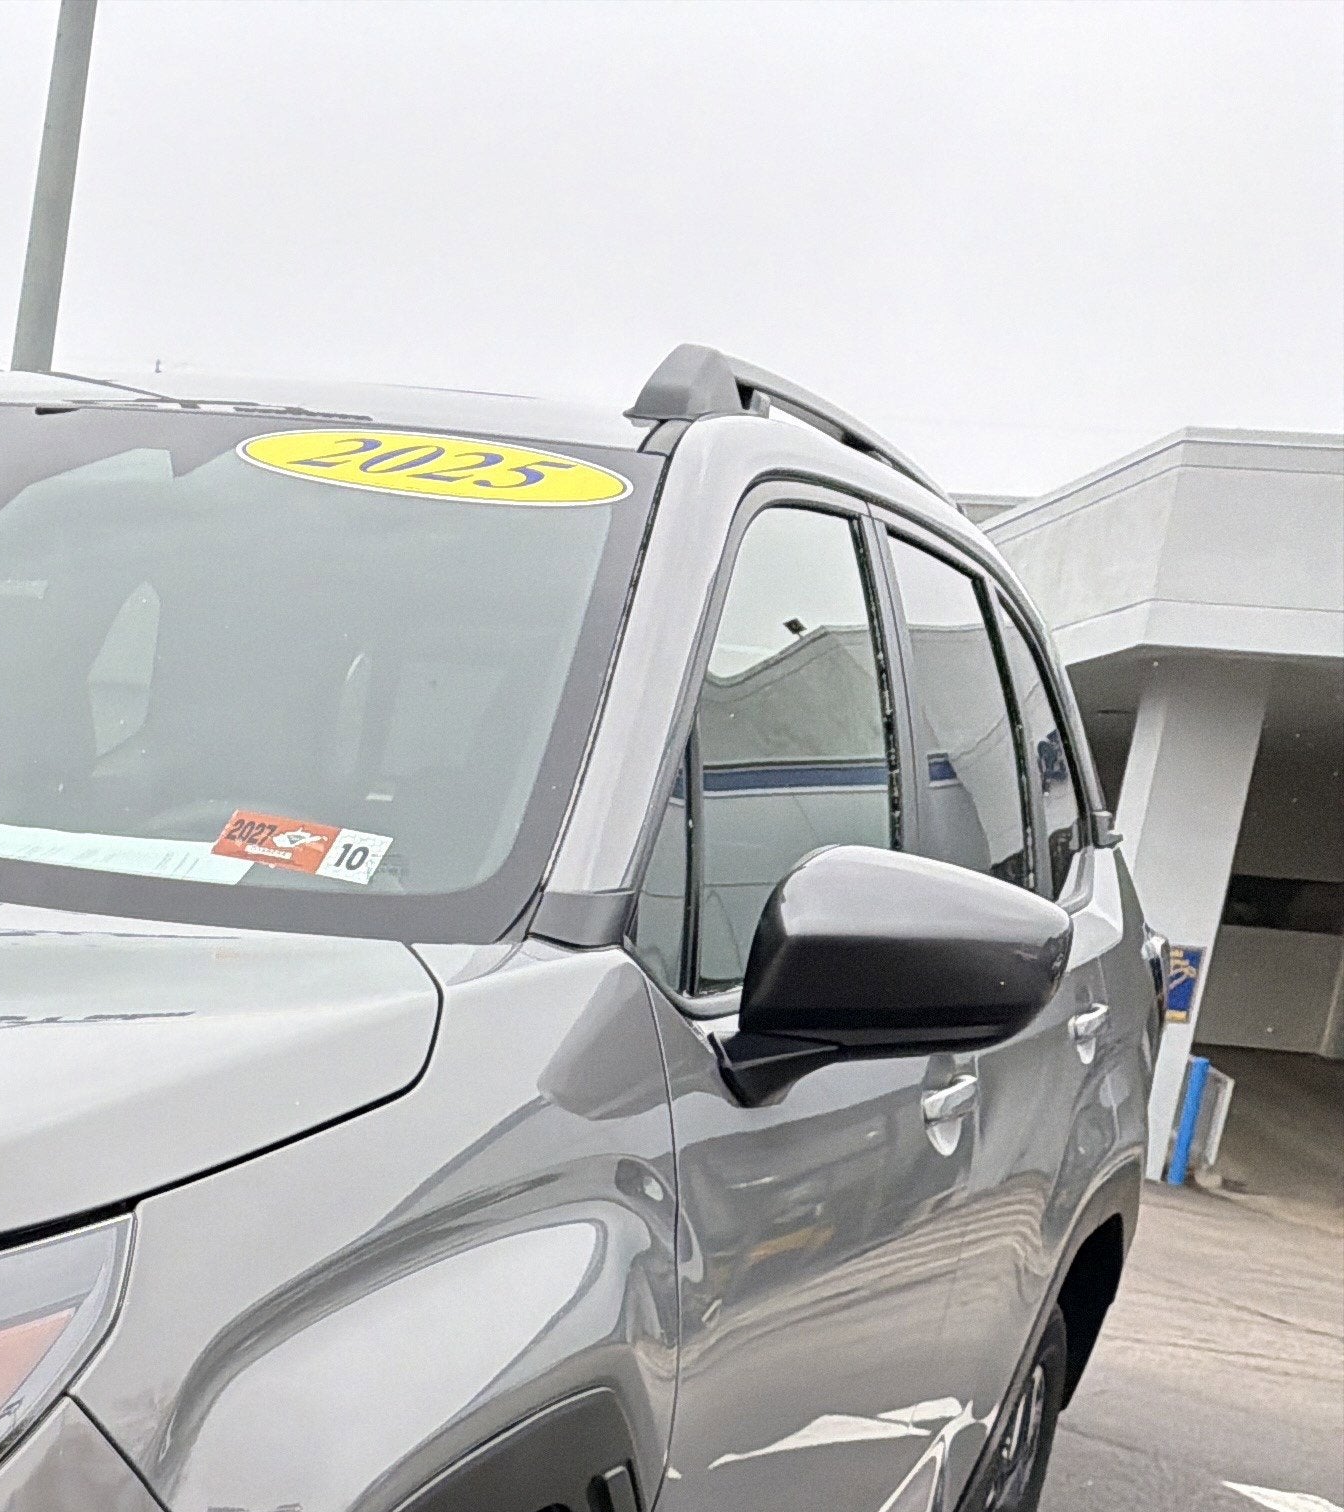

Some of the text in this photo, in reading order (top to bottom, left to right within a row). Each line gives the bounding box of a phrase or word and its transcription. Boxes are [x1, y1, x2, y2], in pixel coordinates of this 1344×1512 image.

[287, 438, 577, 489] 2025
[225, 818, 371, 871] 2027 10
